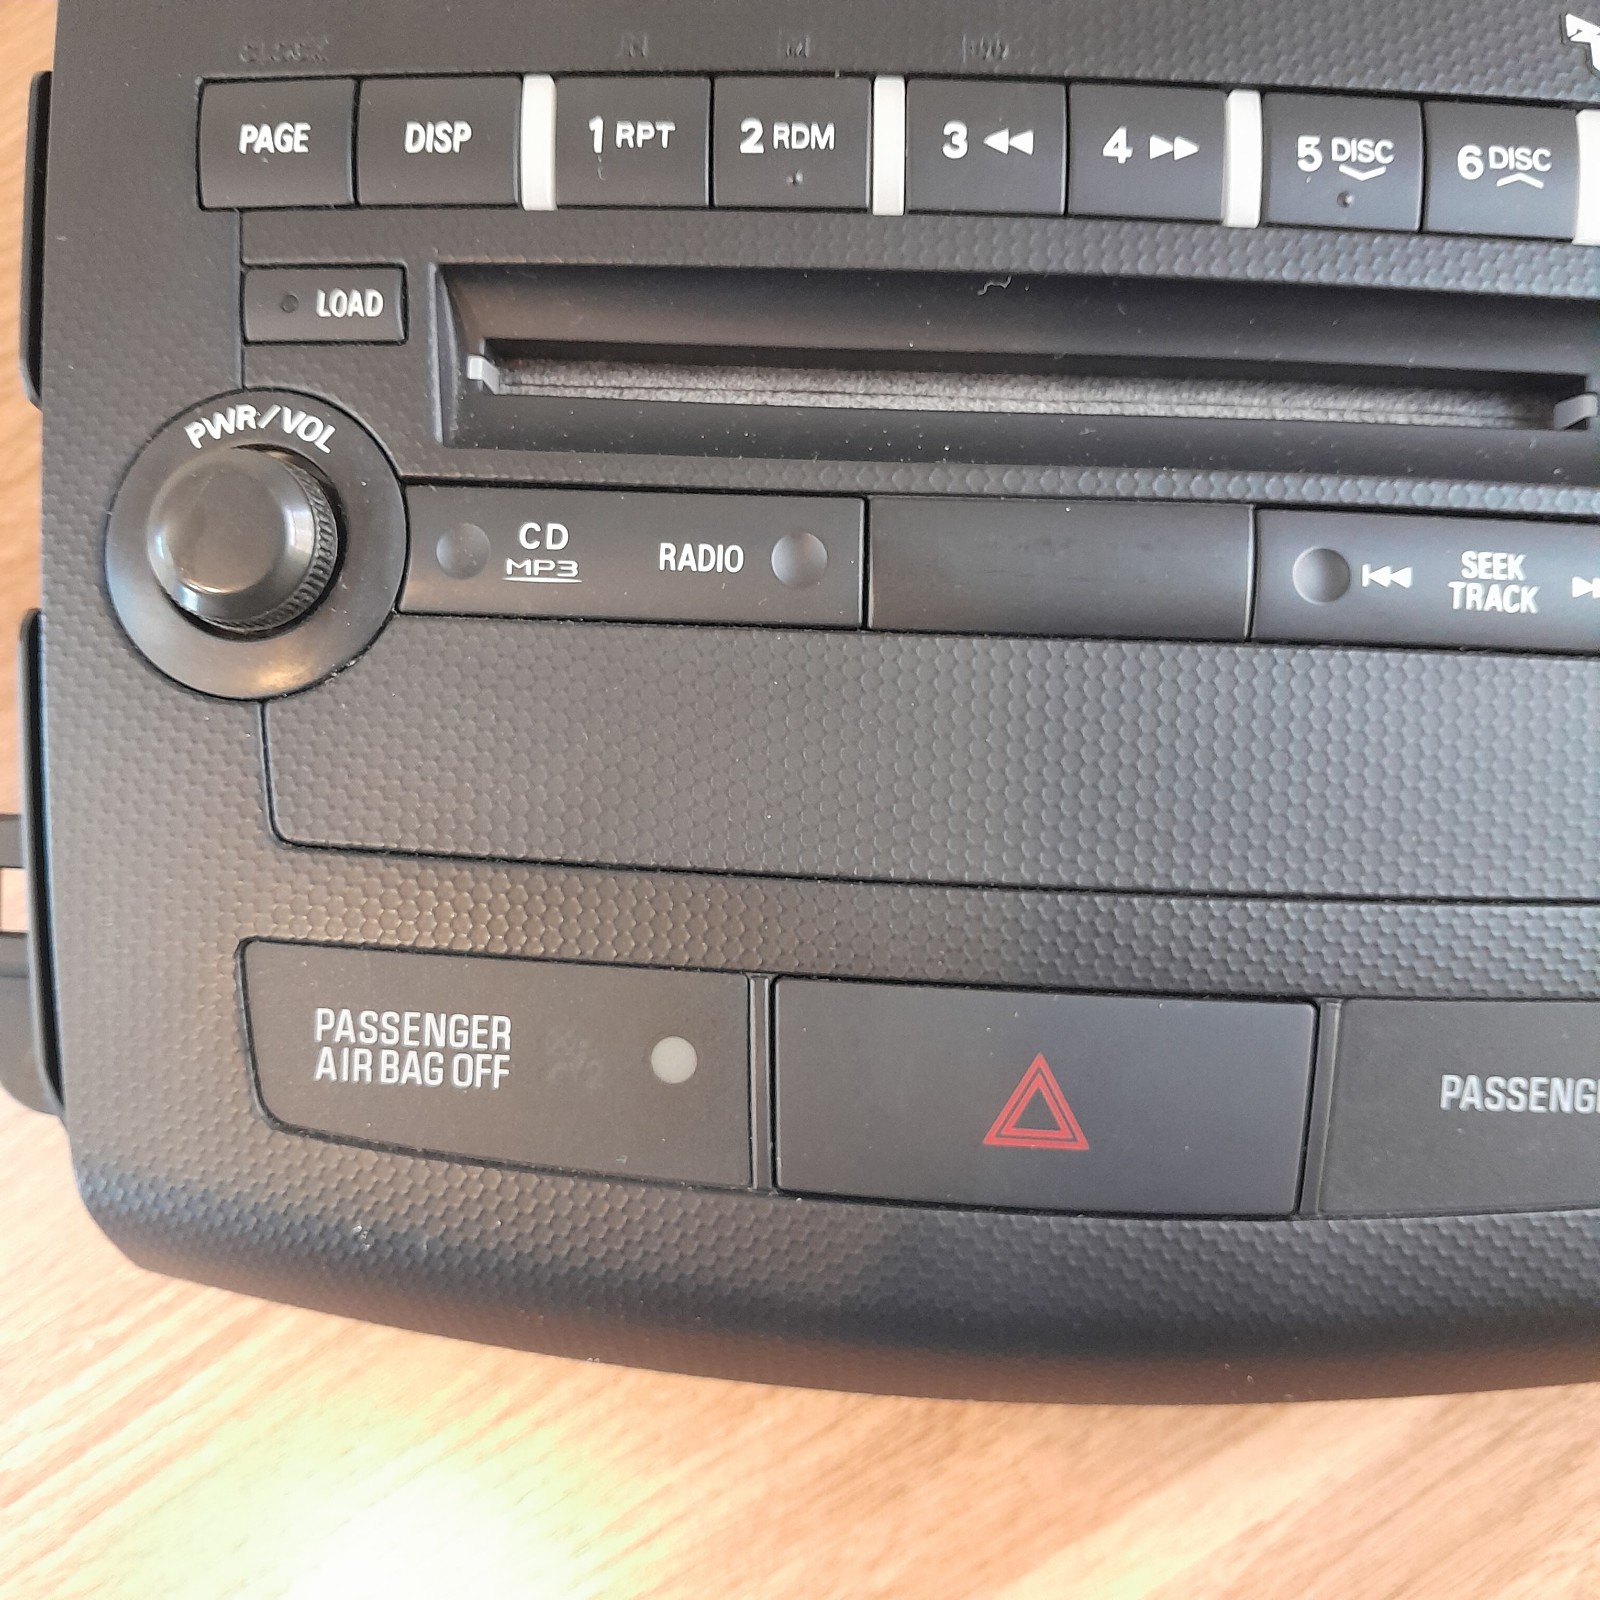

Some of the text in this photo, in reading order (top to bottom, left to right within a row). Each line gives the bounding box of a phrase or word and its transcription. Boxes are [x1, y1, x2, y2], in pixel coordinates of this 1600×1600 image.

[238, 122, 311, 155] PAGE
[404, 121, 472, 154] DISP
[587, 116, 676, 154] 1 RPT
[739, 118, 836, 154] 2 RDM
[942, 121, 969, 159] 3
[1102, 127, 1133, 164] 4
[1297, 135, 1394, 172] 5 DISC
[1457, 144, 1552, 180] 6 DISC
[316, 289, 384, 318] LOAD
[184, 404, 336, 454] PWR/VOL
[518, 522, 569, 550] CD
[505, 557, 579, 578] MP3
[659, 542, 744, 573] RADIO
[1460, 550, 1526, 581] SEEK
[1447, 581, 1539, 614] TRACK
[315, 1007, 512, 1051] PASSENGER
[314, 1046, 511, 1089] AIR BAG OFF
[1439, 1074, 1600, 1114] PASSENG
